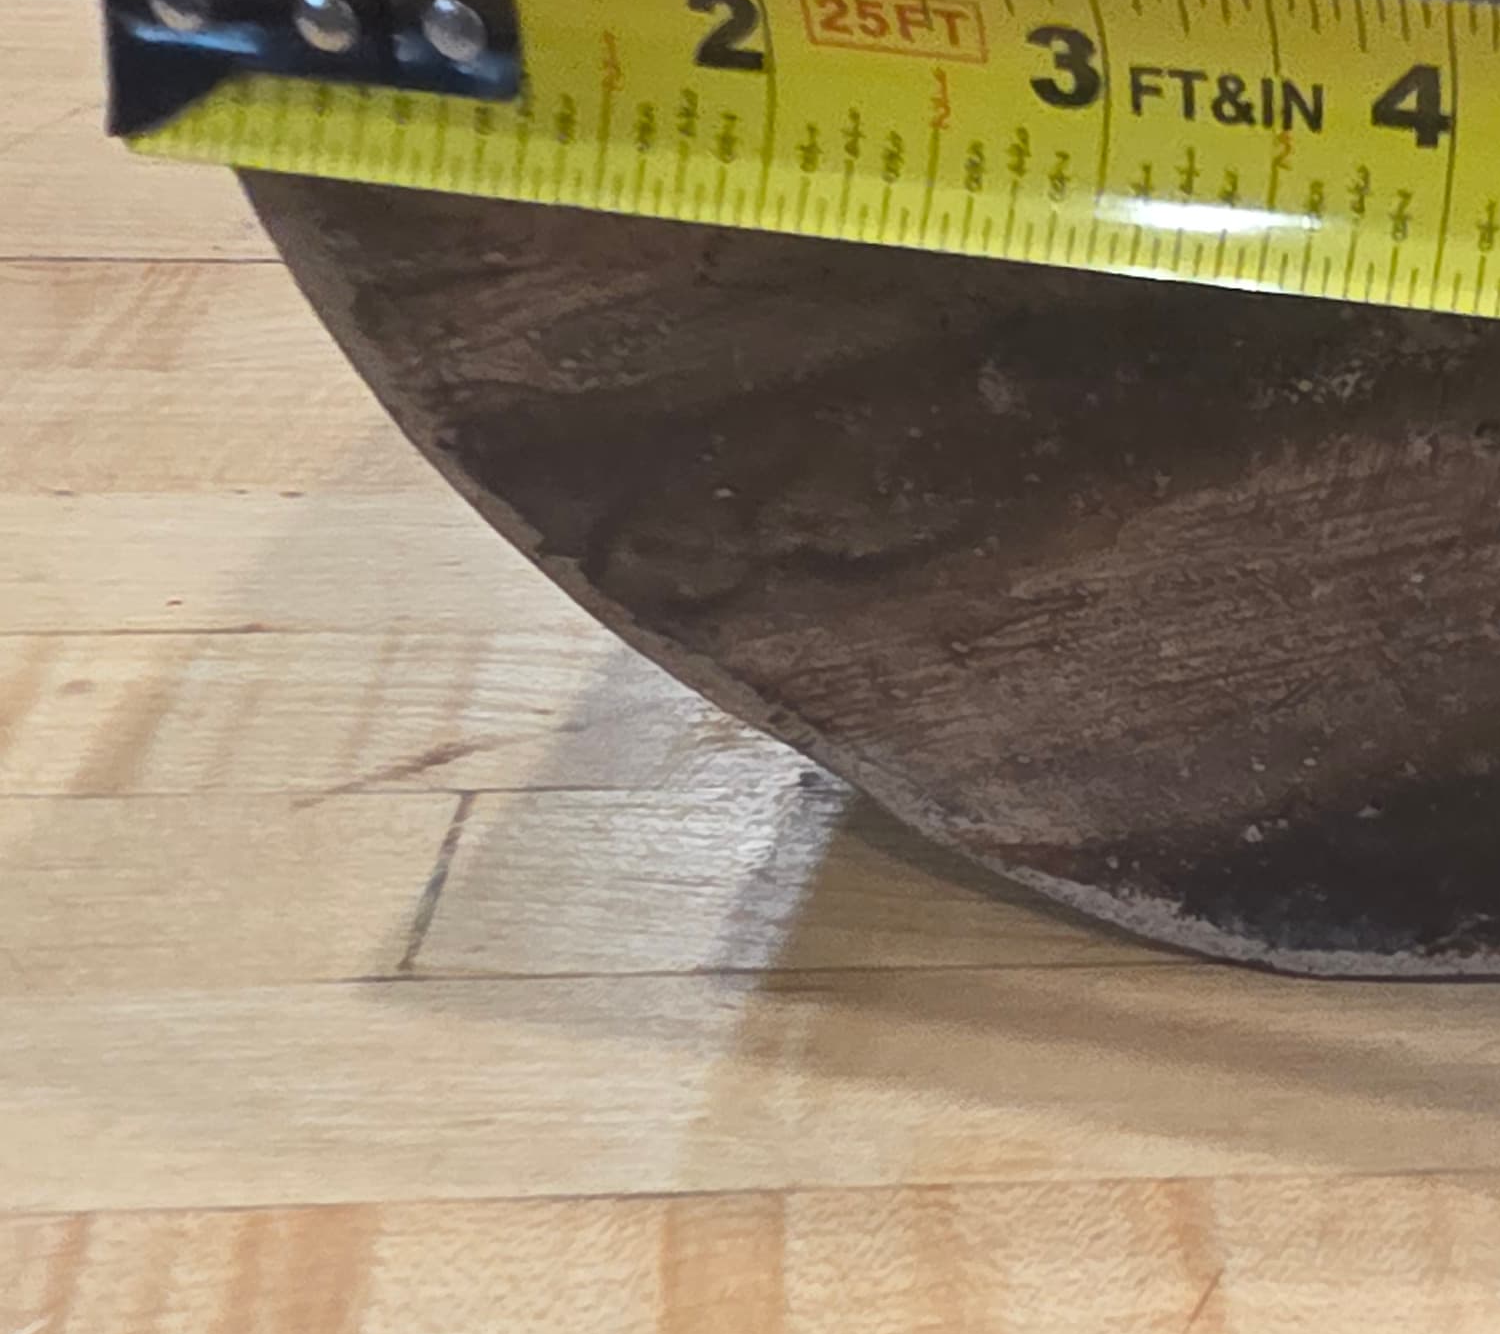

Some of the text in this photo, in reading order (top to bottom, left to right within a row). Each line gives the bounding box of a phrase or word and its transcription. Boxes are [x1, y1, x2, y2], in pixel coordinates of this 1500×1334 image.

[1026, 23, 1105, 110] 3
[1129, 64, 1325, 134] FT&IN
[1370, 63, 1453, 150] 4
